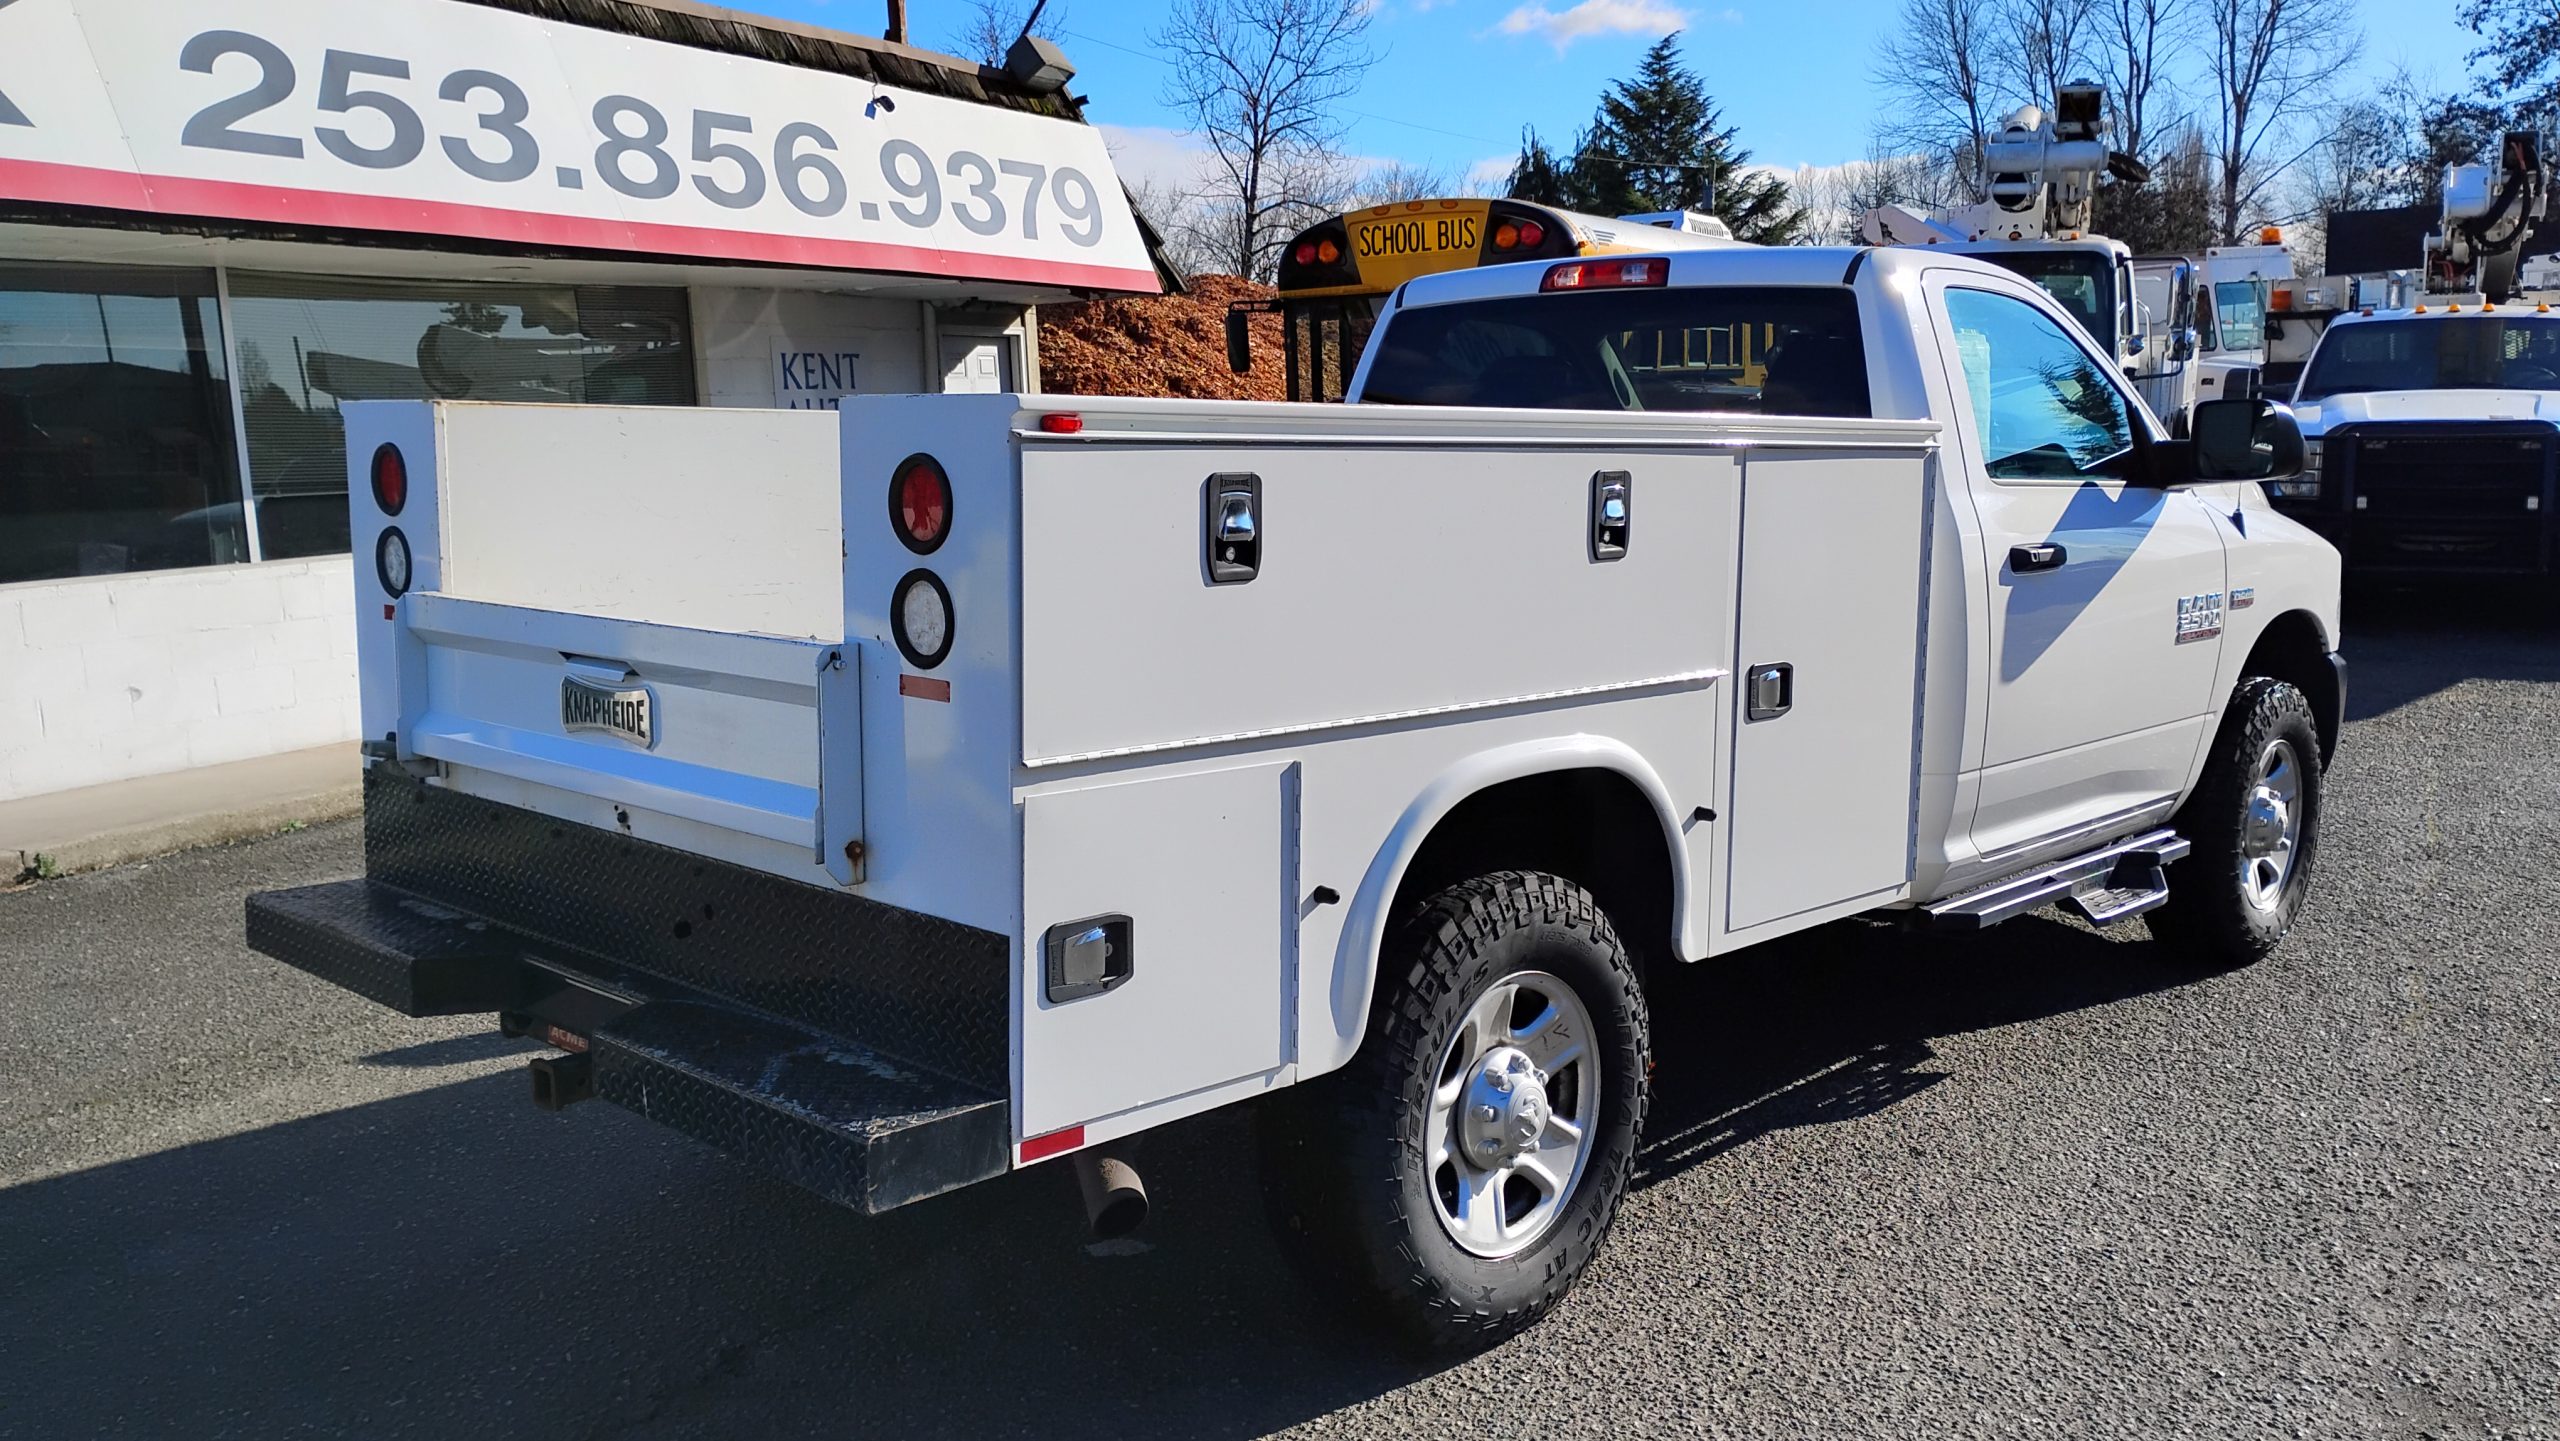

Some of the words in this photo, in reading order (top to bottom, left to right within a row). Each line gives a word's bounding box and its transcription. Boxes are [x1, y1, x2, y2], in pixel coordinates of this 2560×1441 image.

[180, 29, 1102, 248] 253.856.9379
[1359, 221, 1432, 257] SCHOOL
[1438, 217, 1476, 250] BUS
[780, 352, 860, 390] KENT
[2177, 592, 2223, 615] RAM
[2177, 608, 2221, 634] 2500
[564, 686, 647, 739] KNAPHEIDE
[550, 1026, 586, 1049] ACME
[1407, 959, 1490, 1171] HERCULES
[1576, 1147, 1624, 1245] TRAC
[1542, 1246, 1569, 1289] AT
